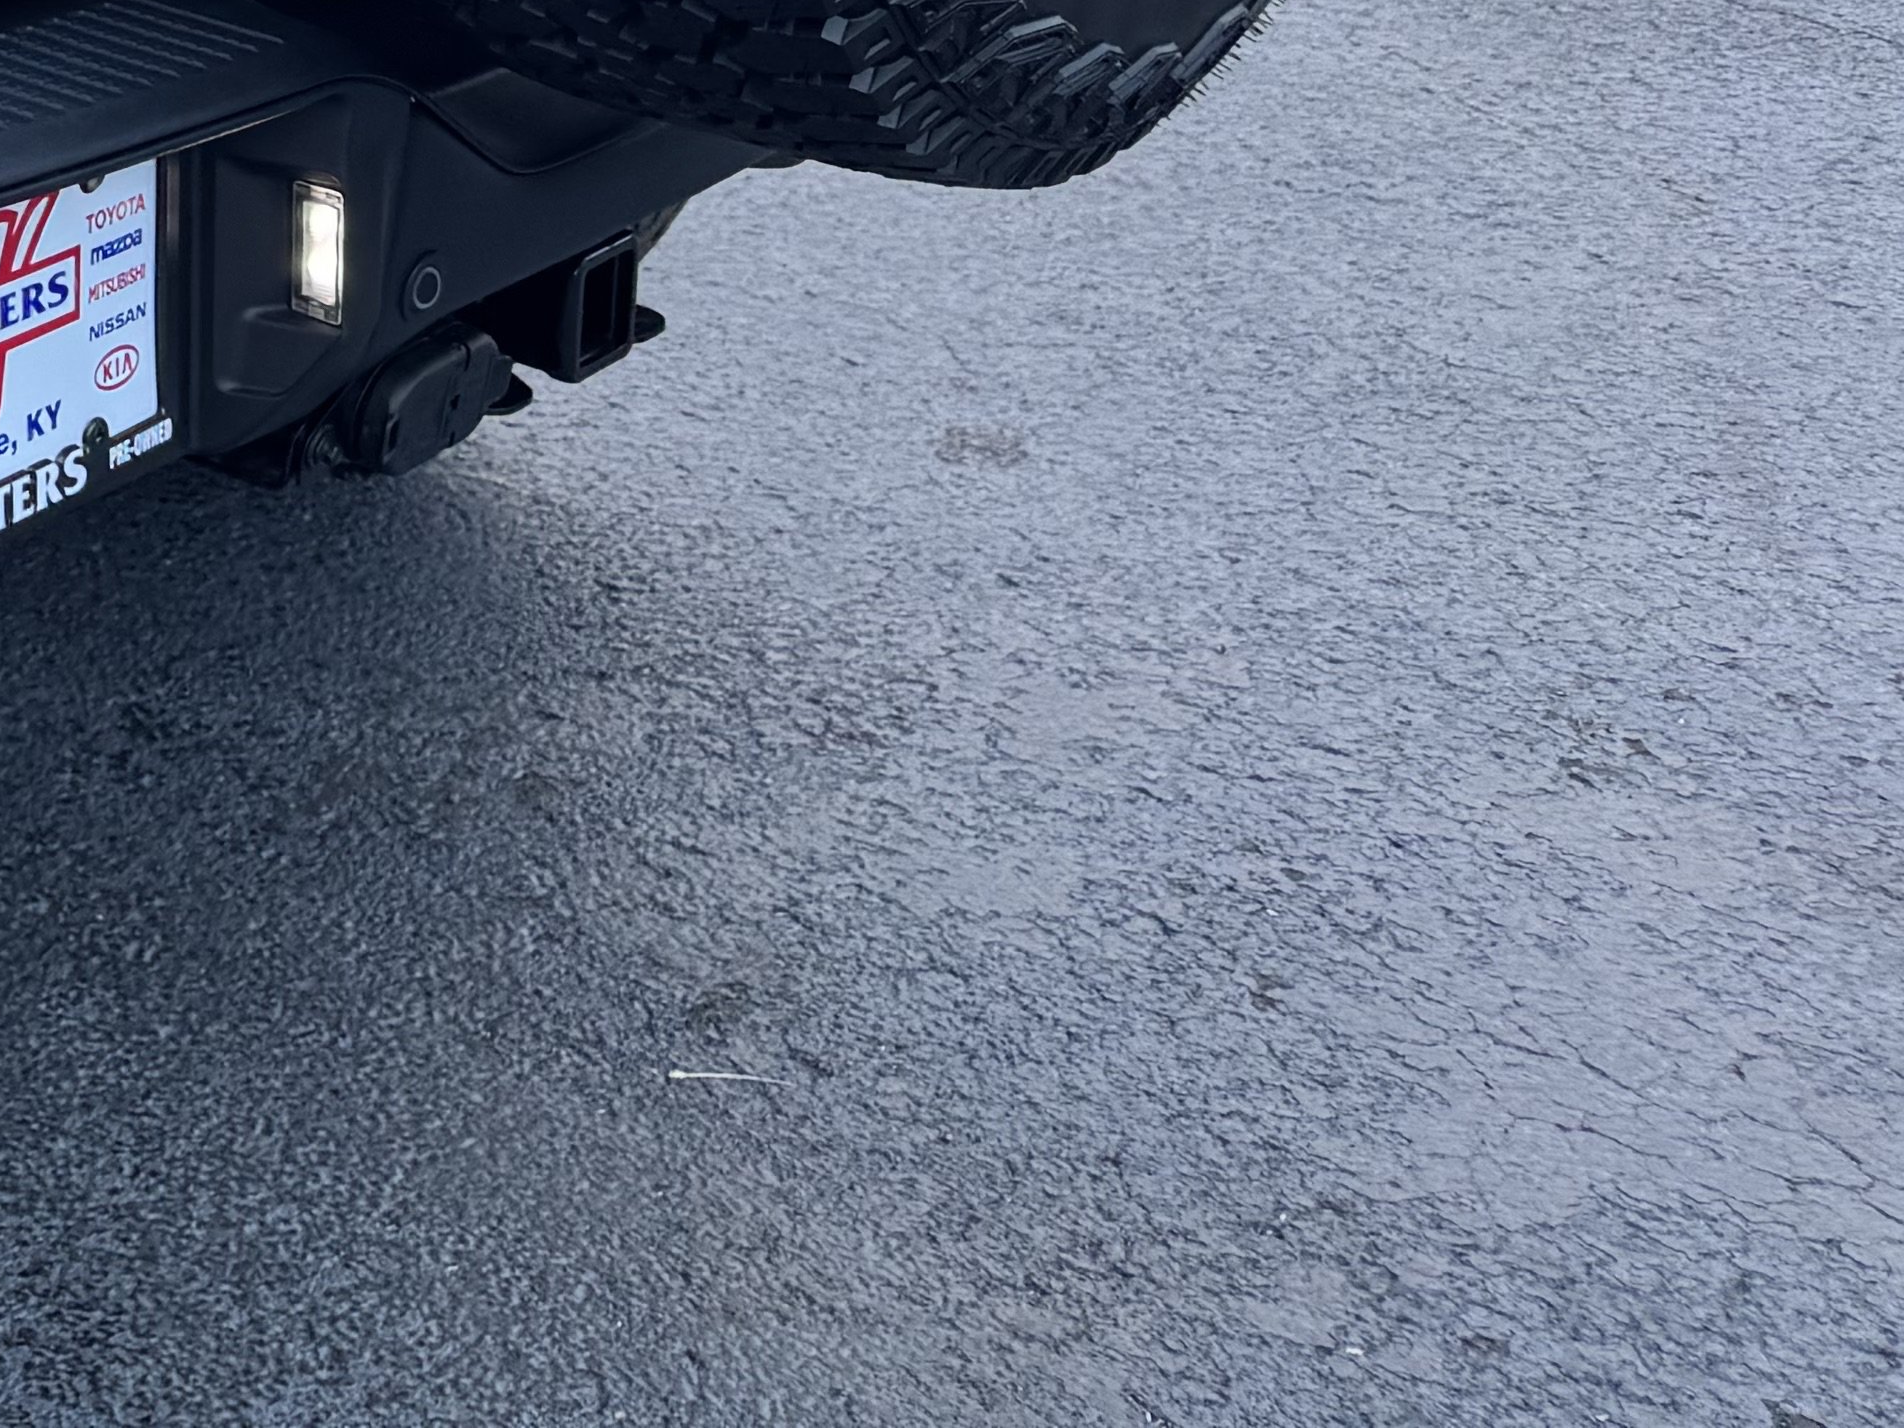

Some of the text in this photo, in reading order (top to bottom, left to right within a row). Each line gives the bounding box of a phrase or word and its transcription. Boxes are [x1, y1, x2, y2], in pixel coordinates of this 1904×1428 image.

[85, 193, 146, 234] TOYOTA
[88, 263, 146, 304] MITSUBISHI
[88, 302, 147, 342] NISSAN
[103, 352, 133, 384] KIA
[25, 400, 63, 442] KY
